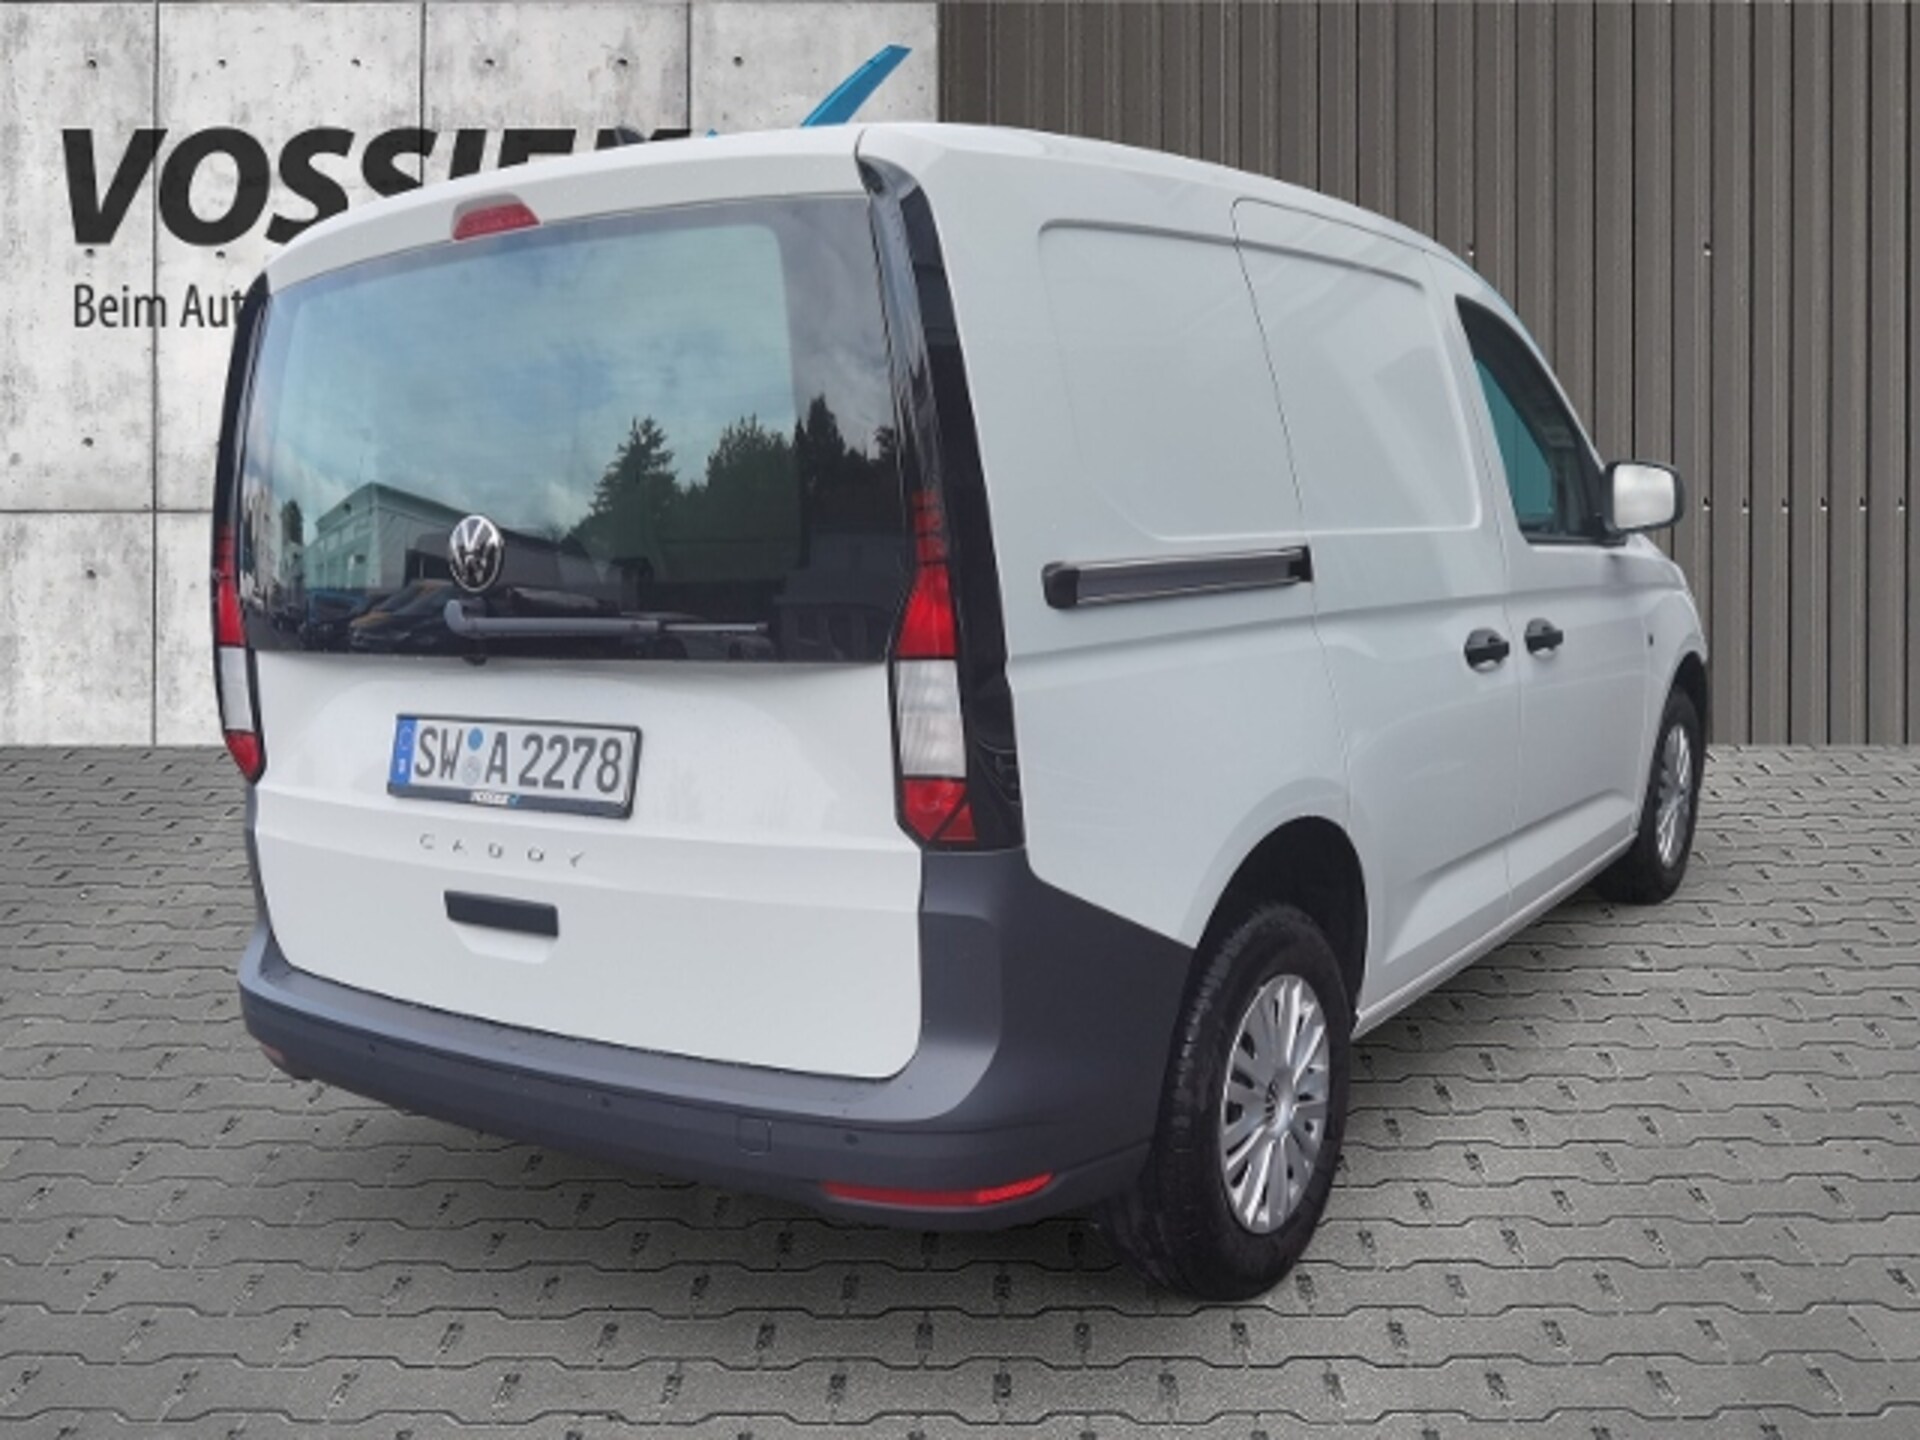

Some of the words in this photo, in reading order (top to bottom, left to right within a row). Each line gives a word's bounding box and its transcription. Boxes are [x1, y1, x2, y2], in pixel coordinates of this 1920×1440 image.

[74, 283, 167, 328] Beim
[414, 726, 463, 781] SW
[485, 731, 508, 785] A
[518, 733, 623, 793] 2278
[419, 832, 586, 868] CADDY
